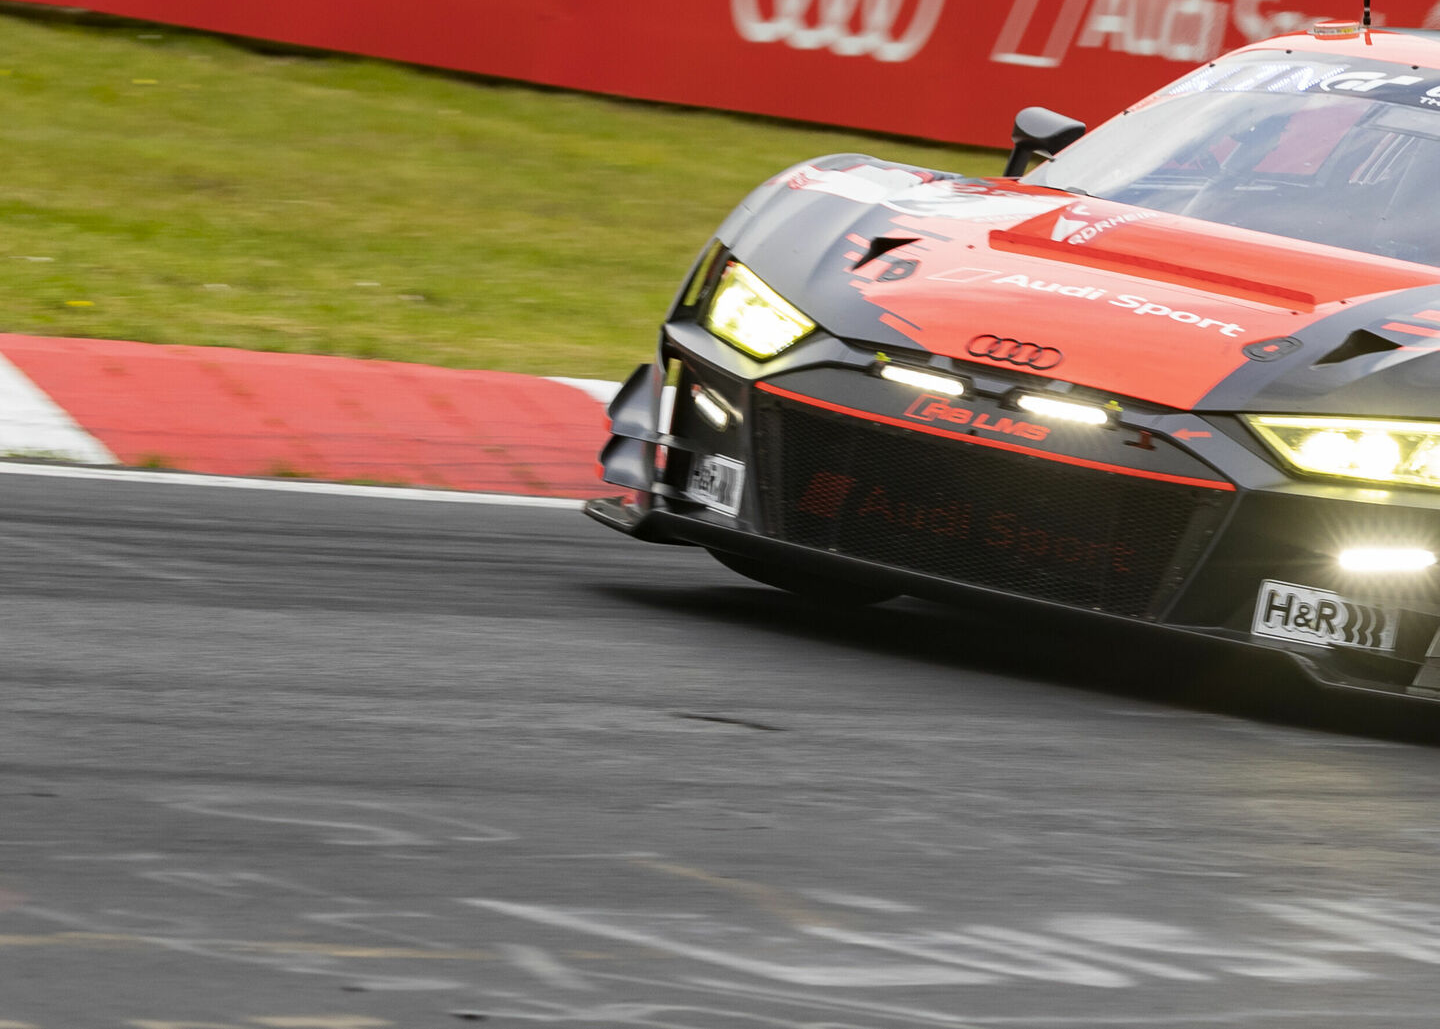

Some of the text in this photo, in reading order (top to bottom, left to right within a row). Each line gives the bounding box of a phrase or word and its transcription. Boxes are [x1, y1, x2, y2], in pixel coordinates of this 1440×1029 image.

[992, 274, 1246, 337] Audi Sport
[970, 413, 1052, 442] LMS
[858, 485, 1137, 573] Audi Sport
[1263, 589, 1338, 637] H&R
